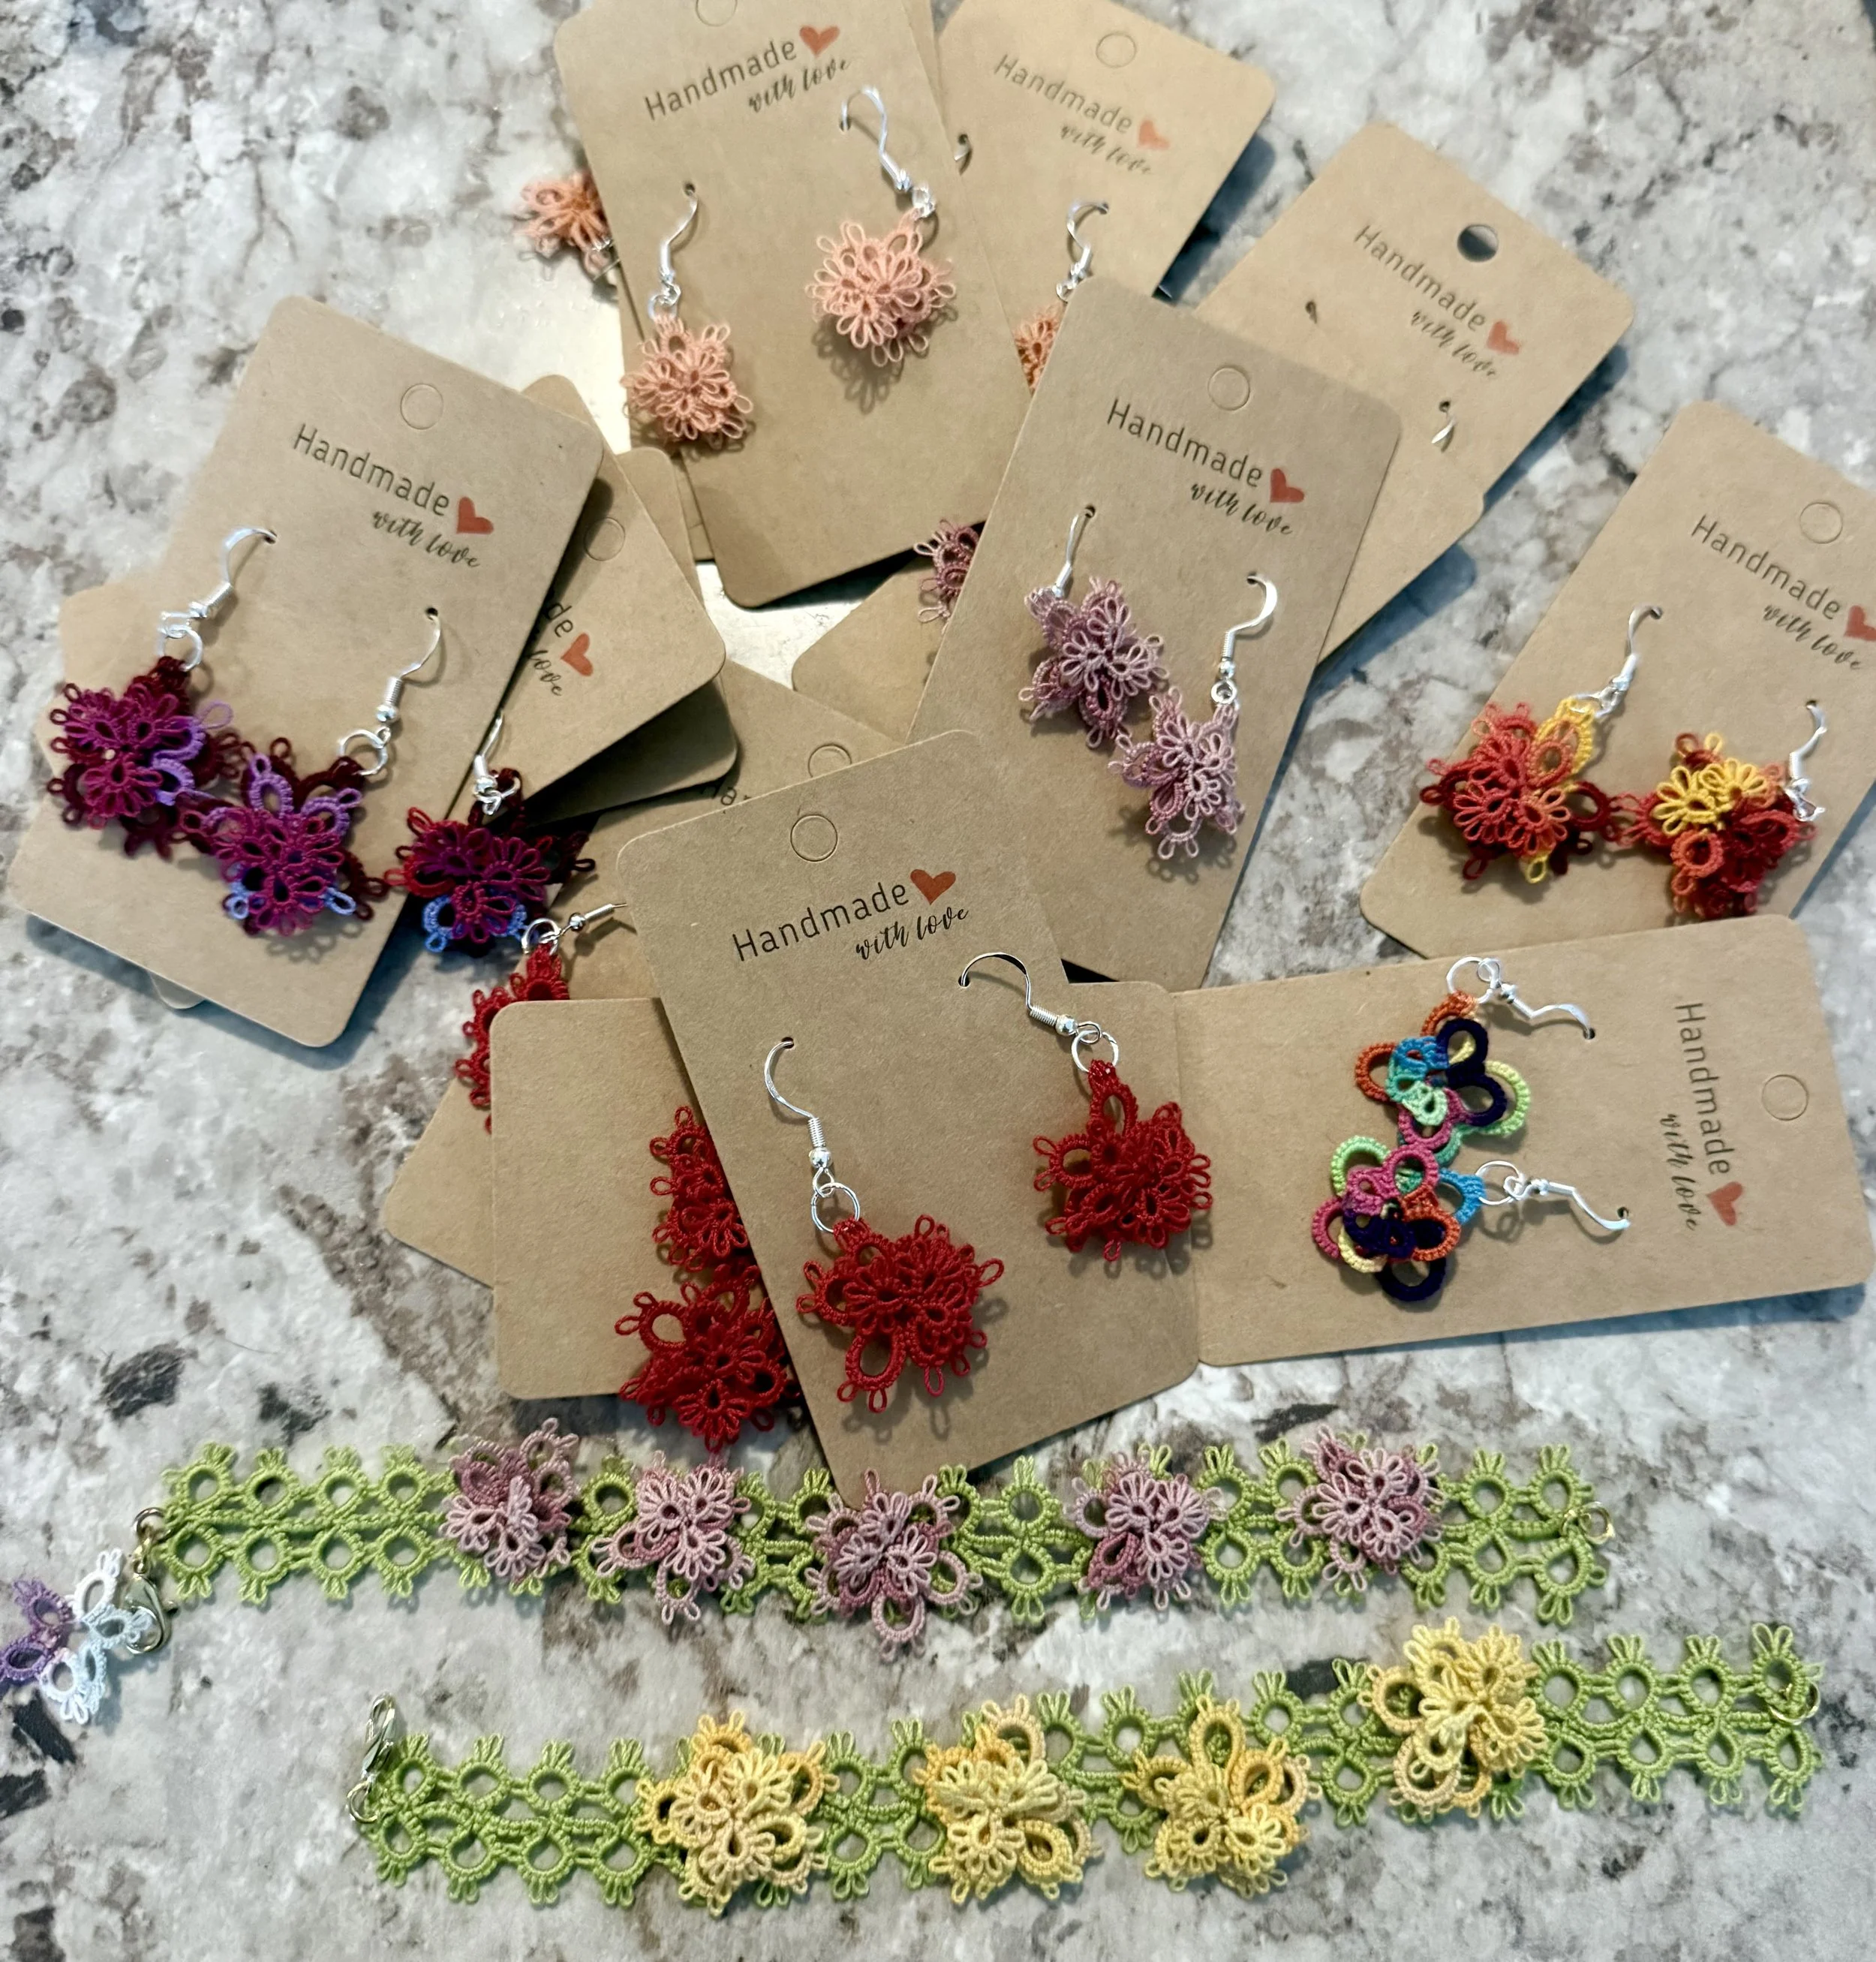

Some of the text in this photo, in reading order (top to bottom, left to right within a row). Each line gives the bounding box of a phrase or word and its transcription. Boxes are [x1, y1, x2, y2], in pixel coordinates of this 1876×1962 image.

[644, 39, 797, 120] Handmade
[748, 58, 850, 113] with love
[994, 54, 1132, 133] Handmade
[1060, 123, 1151, 174] with love
[1354, 224, 1486, 332] Handmade
[1411, 311, 1496, 376] with love
[293, 423, 449, 516] Handmade
[1107, 398, 1263, 488] Handmade
[372, 510, 480, 568] with love
[1191, 483, 1292, 535] with love
[1691, 514, 1841, 620] Handmade
[1763, 605, 1861, 670] with love
[732, 882, 909, 961] Handmade
[856, 906, 969, 960] with love
[1674, 1003, 1735, 1175] Handmade
[1660, 1114, 1701, 1230] with love
